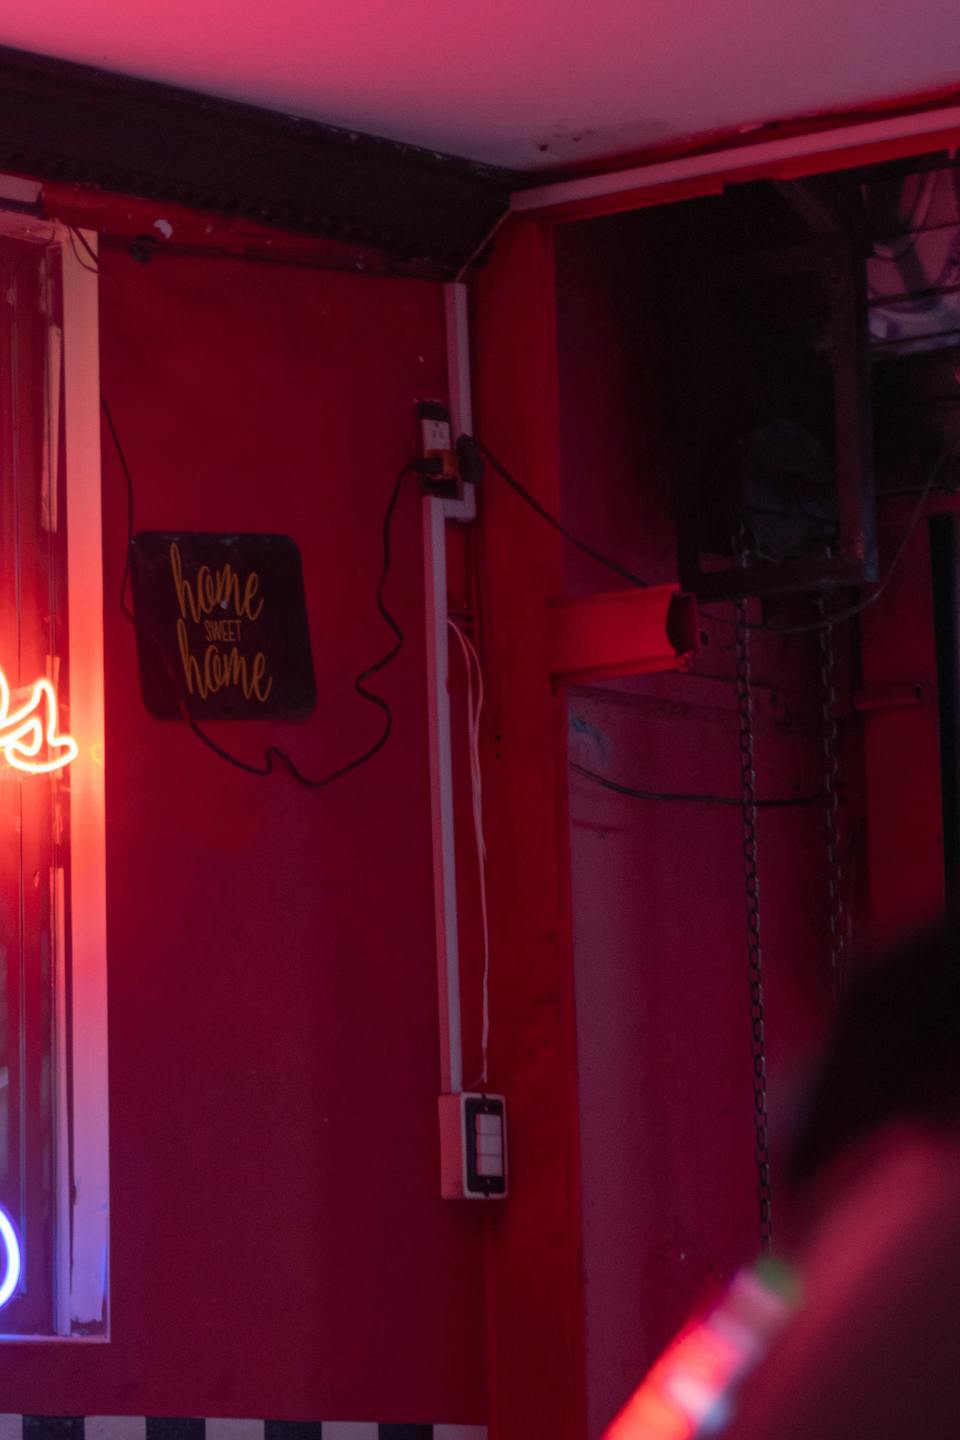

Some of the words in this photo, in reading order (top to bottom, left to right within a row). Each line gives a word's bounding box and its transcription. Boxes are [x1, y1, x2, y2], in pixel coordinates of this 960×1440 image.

[170, 542, 264, 624] home
[176, 617, 273, 702] home
[204, 619, 242, 642] SWEET
